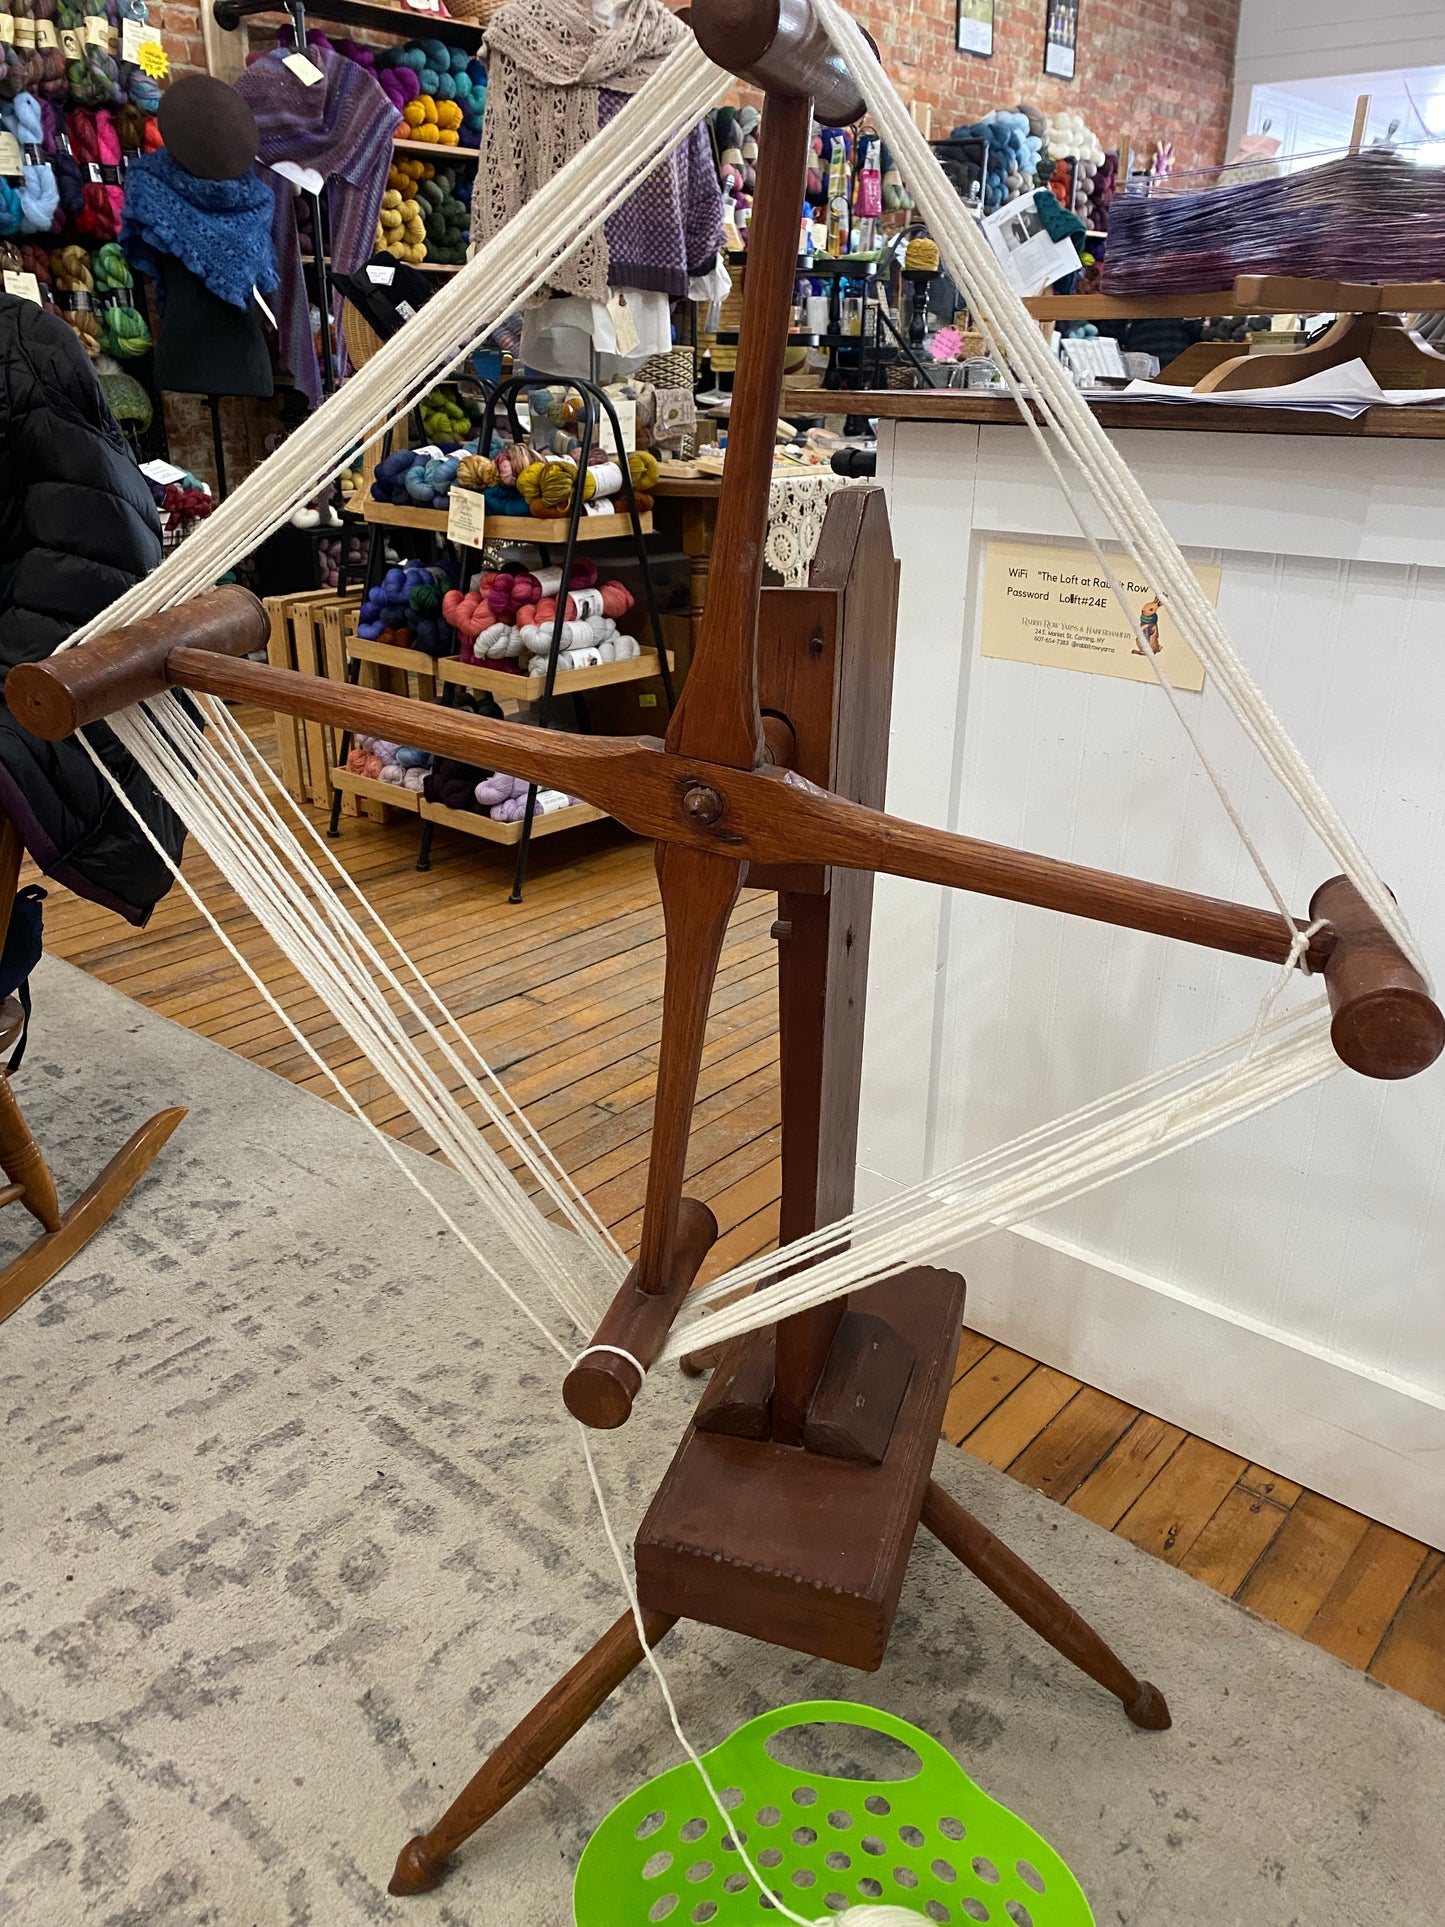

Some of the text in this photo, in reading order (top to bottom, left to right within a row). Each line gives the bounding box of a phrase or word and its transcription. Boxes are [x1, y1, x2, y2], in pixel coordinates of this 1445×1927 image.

[1008, 567, 1028, 579] WiFi
[1060, 573, 1079, 585] Loft
[1080, 577, 1091, 587] at
[1093, 577, 1125, 591] Rabt
[1007, 586, 1050, 601] Password
